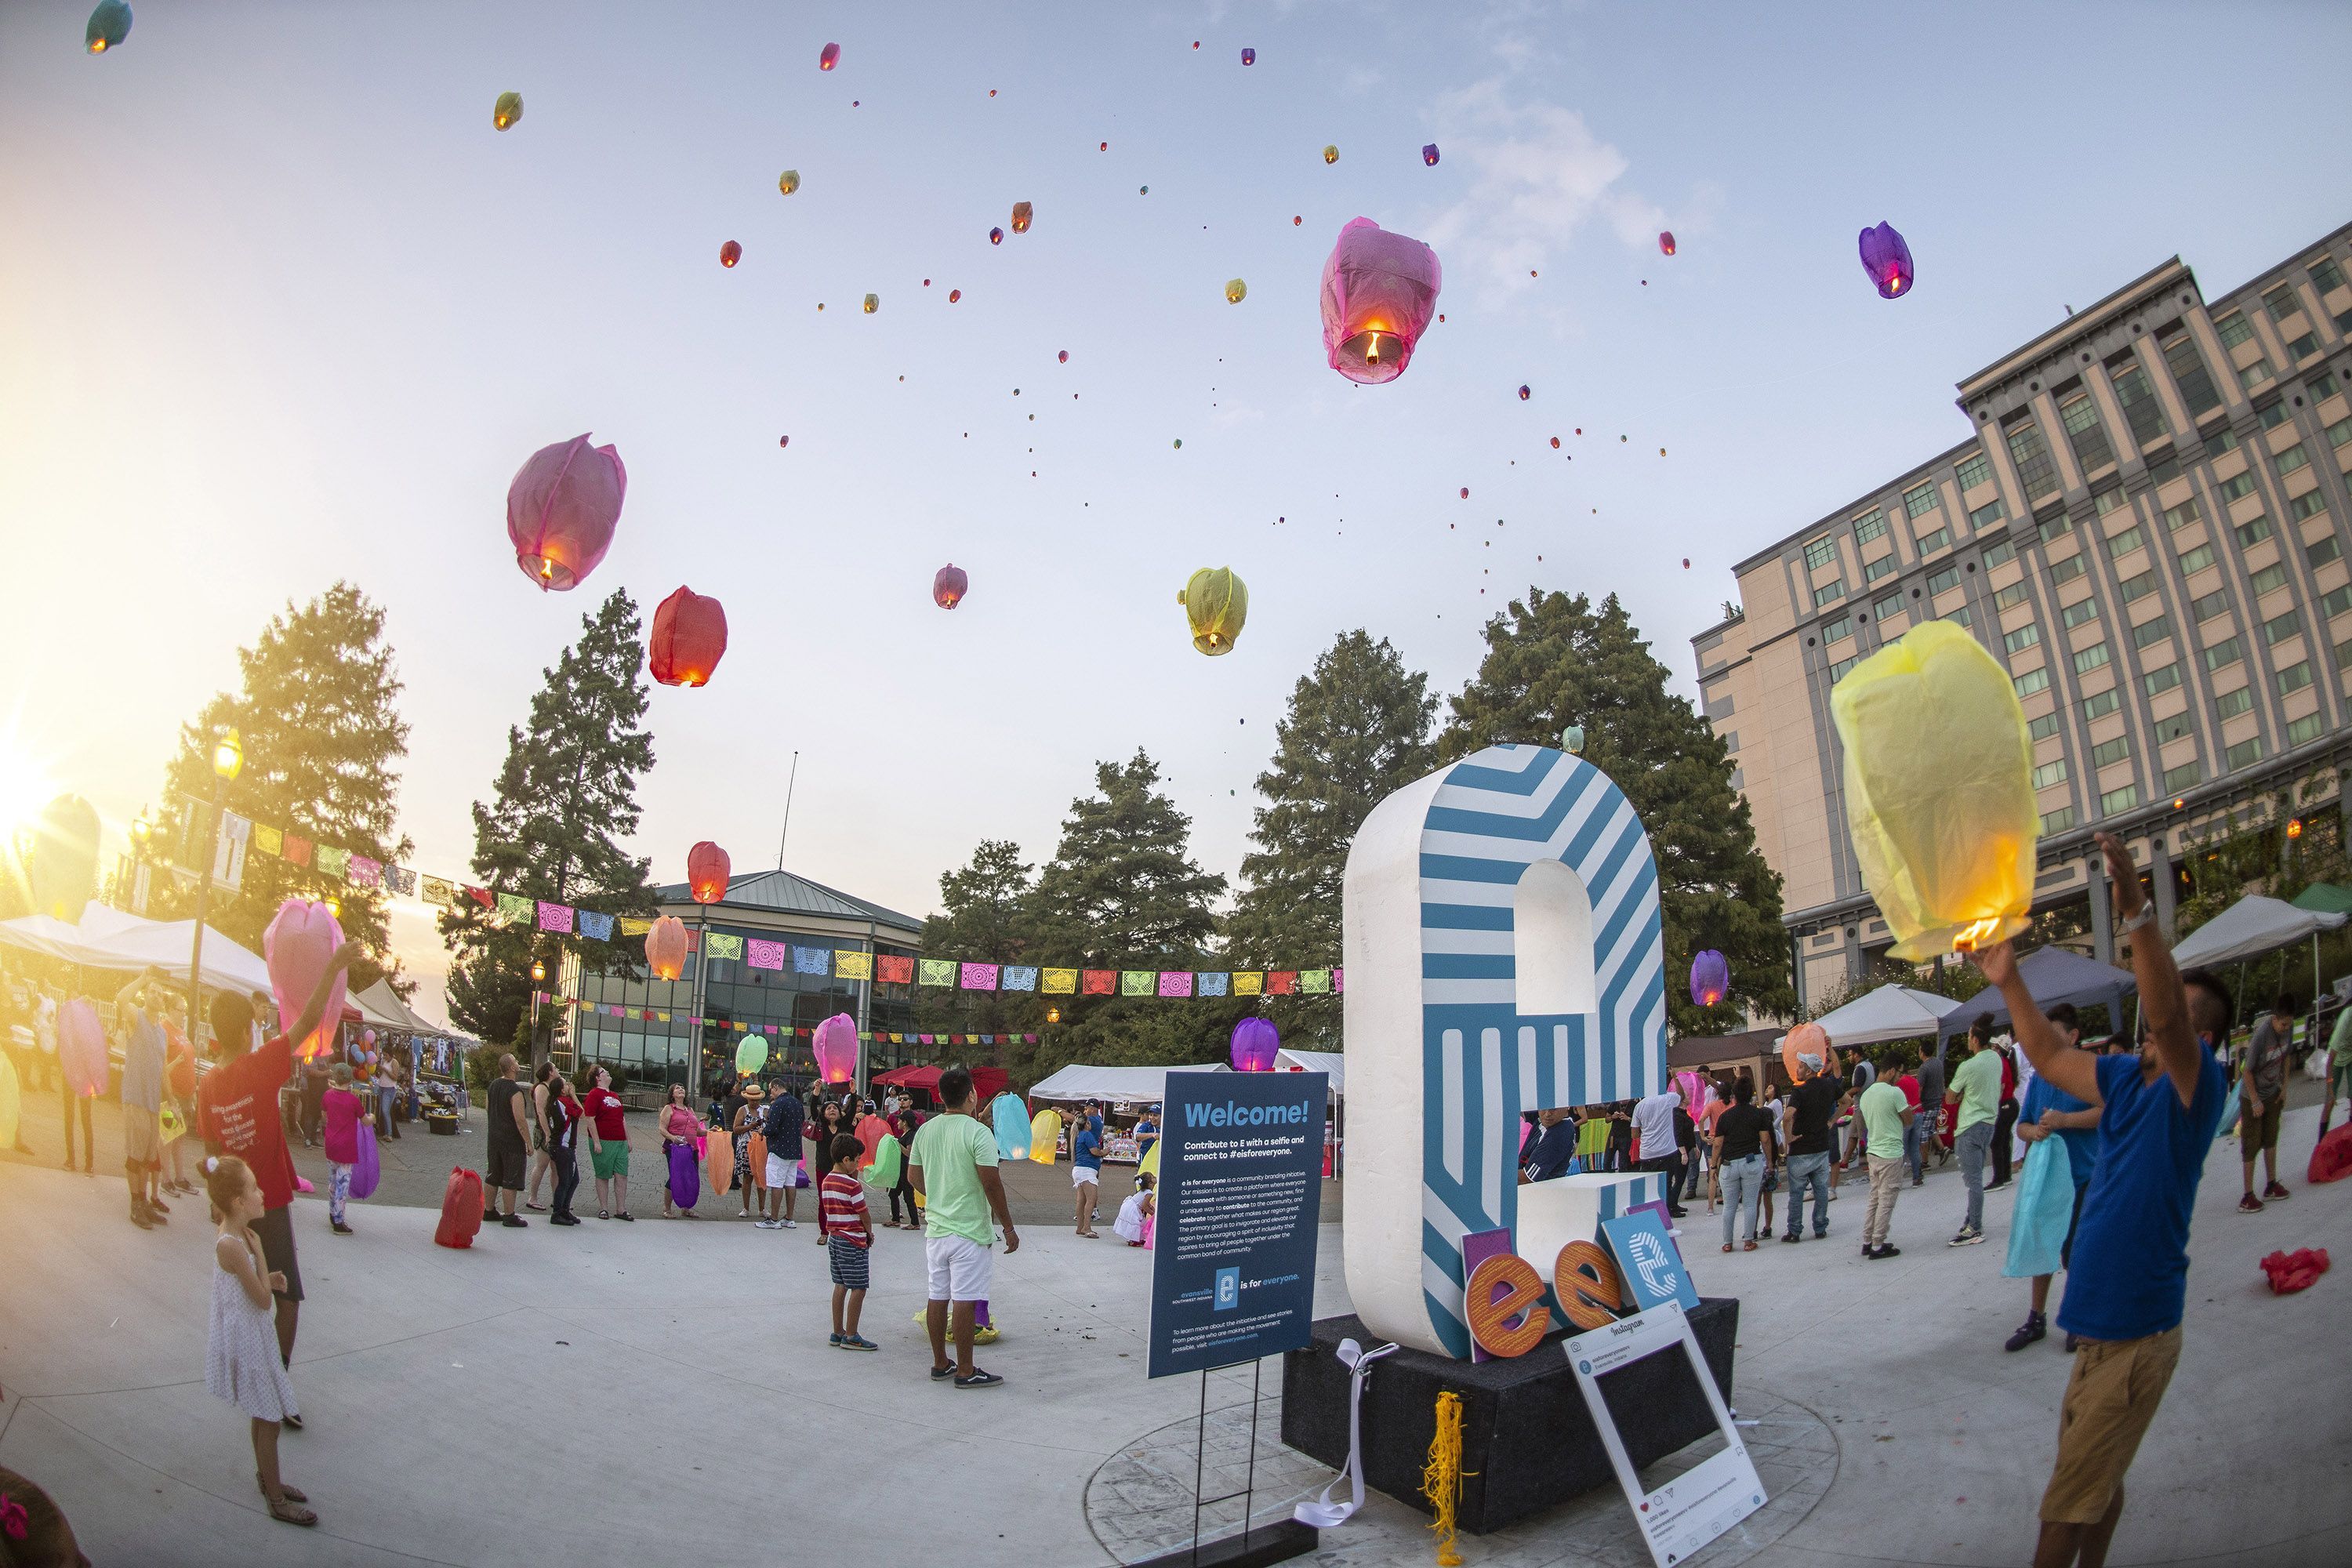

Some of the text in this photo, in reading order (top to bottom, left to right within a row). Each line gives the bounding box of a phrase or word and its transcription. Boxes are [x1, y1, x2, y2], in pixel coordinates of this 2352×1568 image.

[225, 1096, 254, 1112] awareness
[223, 1113, 242, 1123] for the
[1185, 1101, 1308, 1127] Welcome!
[235, 1119, 255, 1131] disease
[1185, 1140, 1228, 1150] Contribute
[1270, 1136, 1290, 1145] selfie
[1291, 1135, 1305, 1144] and
[1184, 1152, 1217, 1161] connect
[1230, 1148, 1292, 1159] #eisforeveryone.
[1248, 1182, 1269, 1191] platform
[1204, 1231, 1236, 1240] encouraging
[1263, 1274, 1299, 1285] everyone.
[1553, 1240, 1621, 1330] e
[1181, 1288, 1213, 1298] evansville
[1464, 1254, 1551, 1357] e
[1610, 1319, 1645, 1336] Instagram
[1171, 1345, 1196, 1353] possible,
